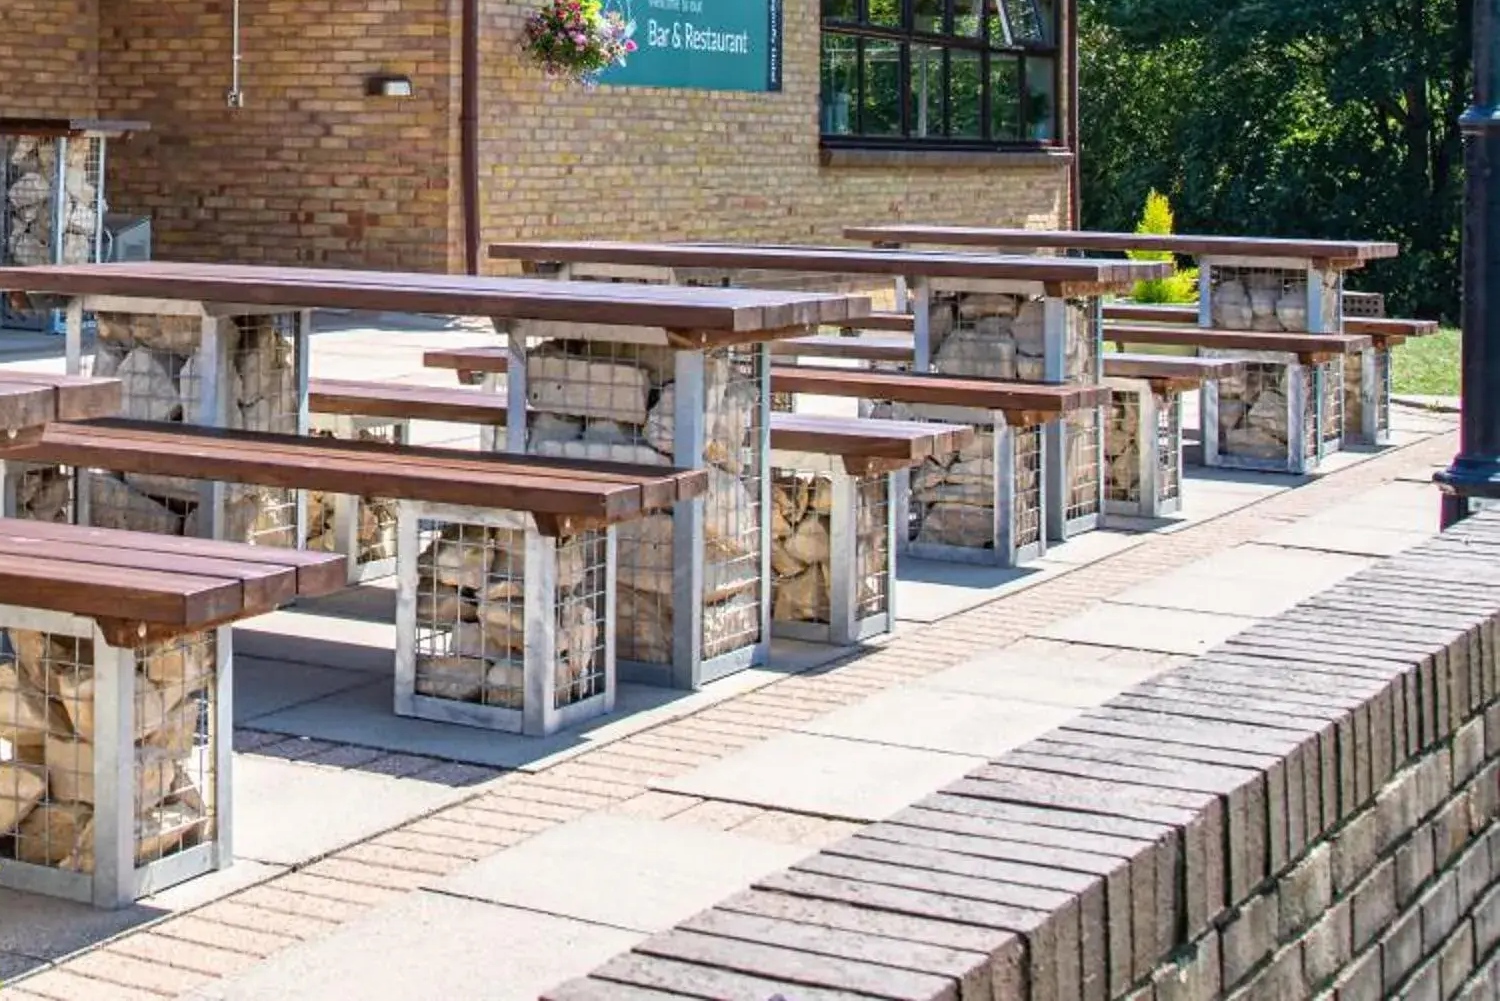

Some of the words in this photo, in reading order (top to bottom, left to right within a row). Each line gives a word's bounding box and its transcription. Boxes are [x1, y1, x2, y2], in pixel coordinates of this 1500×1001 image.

[690, 0, 703, 14] our
[649, 18, 670, 47] Bar
[671, 21, 682, 48] &
[685, 23, 748, 53] Restaurant
